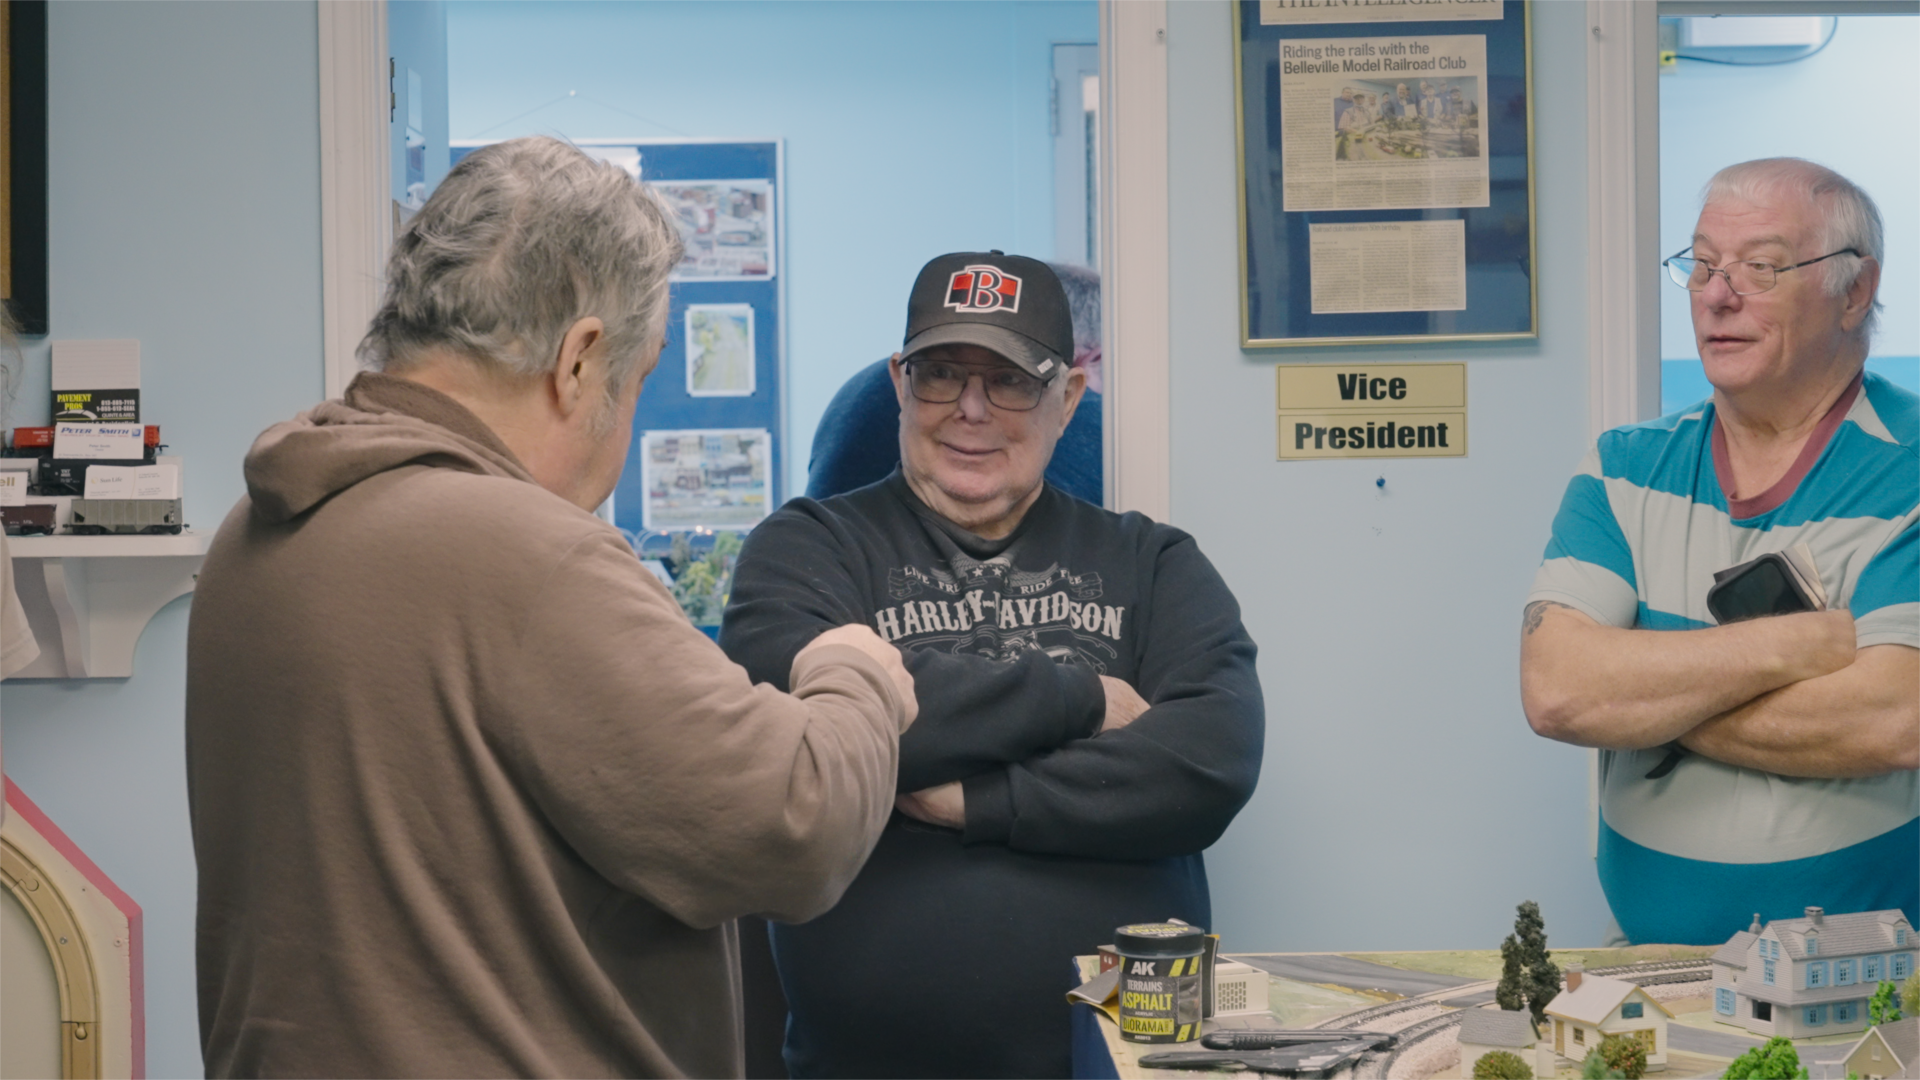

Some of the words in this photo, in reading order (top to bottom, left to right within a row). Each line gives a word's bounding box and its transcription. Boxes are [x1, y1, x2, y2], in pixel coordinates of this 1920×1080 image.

[1283, 45, 1322, 60] Riding
[1325, 44, 1345, 57] the
[1348, 43, 1376, 56] rails
[1379, 42, 1406, 55] with
[1409, 41, 1430, 55] the
[1284, 60, 1340, 74] Belleville
[1343, 58, 1380, 72] Model
[1384, 57, 1435, 71] Railroad
[1439, 56, 1467, 70] Club
[960, 268, 1003, 310] B
[1337, 373, 1407, 401] Vice
[57, 393, 92, 403] PAVEMENT
[64, 402, 84, 411] PROS
[98, 427, 130, 435] SMITH
[1295, 421, 1449, 450] President
[903, 566, 930, 585] LIVE
[938, 580, 961, 594] FRE
[1020, 576, 1053, 595] RIDE
[1060, 569, 1083, 585] FEE
[1131, 961, 1156, 976] AK
[1127, 979, 1163, 992] TERRAINS
[1122, 990, 1173, 1011] ASPHALT
[1123, 1017, 1164, 1033] DIORAMA
